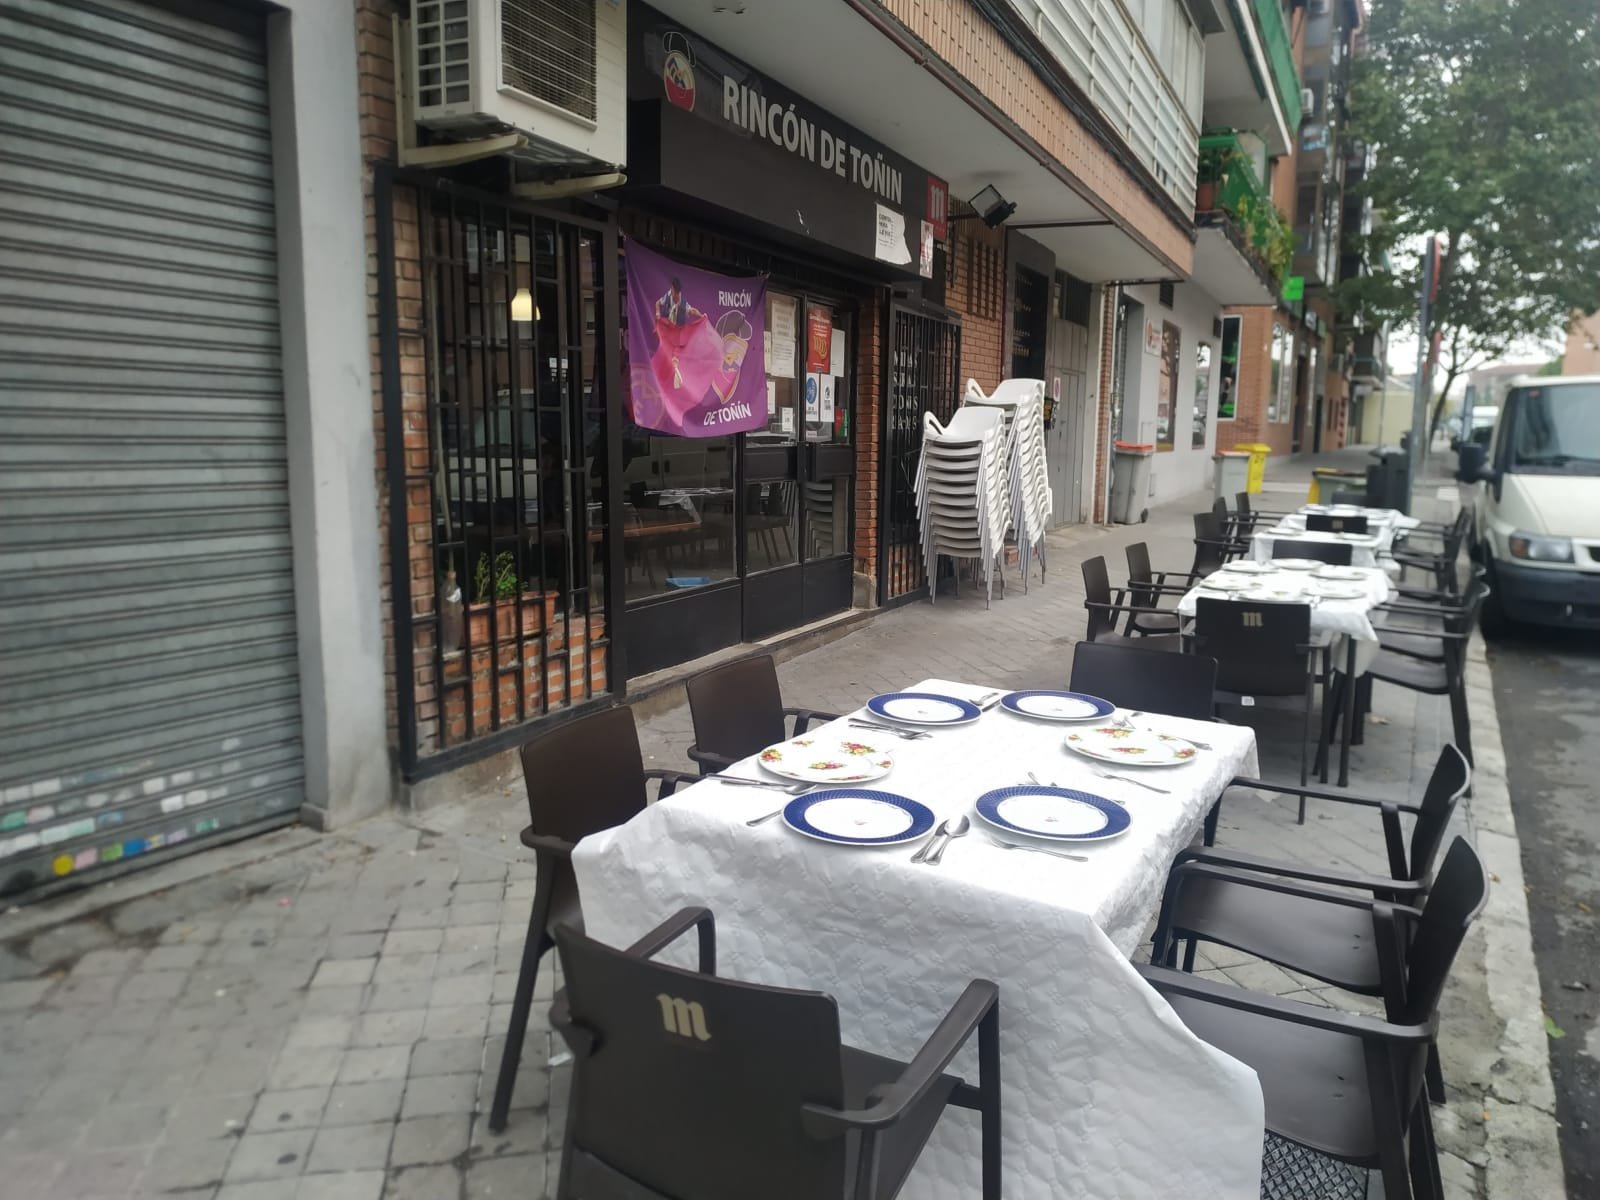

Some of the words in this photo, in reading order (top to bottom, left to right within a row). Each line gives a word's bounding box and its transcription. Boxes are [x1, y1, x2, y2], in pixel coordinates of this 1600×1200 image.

[723, 75, 815, 162] RINCÓN
[820, 129, 847, 178] DE
[849, 145, 902, 205] TOÑIN
[718, 289, 752, 308] RINCÓN
[703, 408, 718, 426] DE
[717, 402, 752, 424] TOÑÍN
[655, 992, 713, 1042] m
